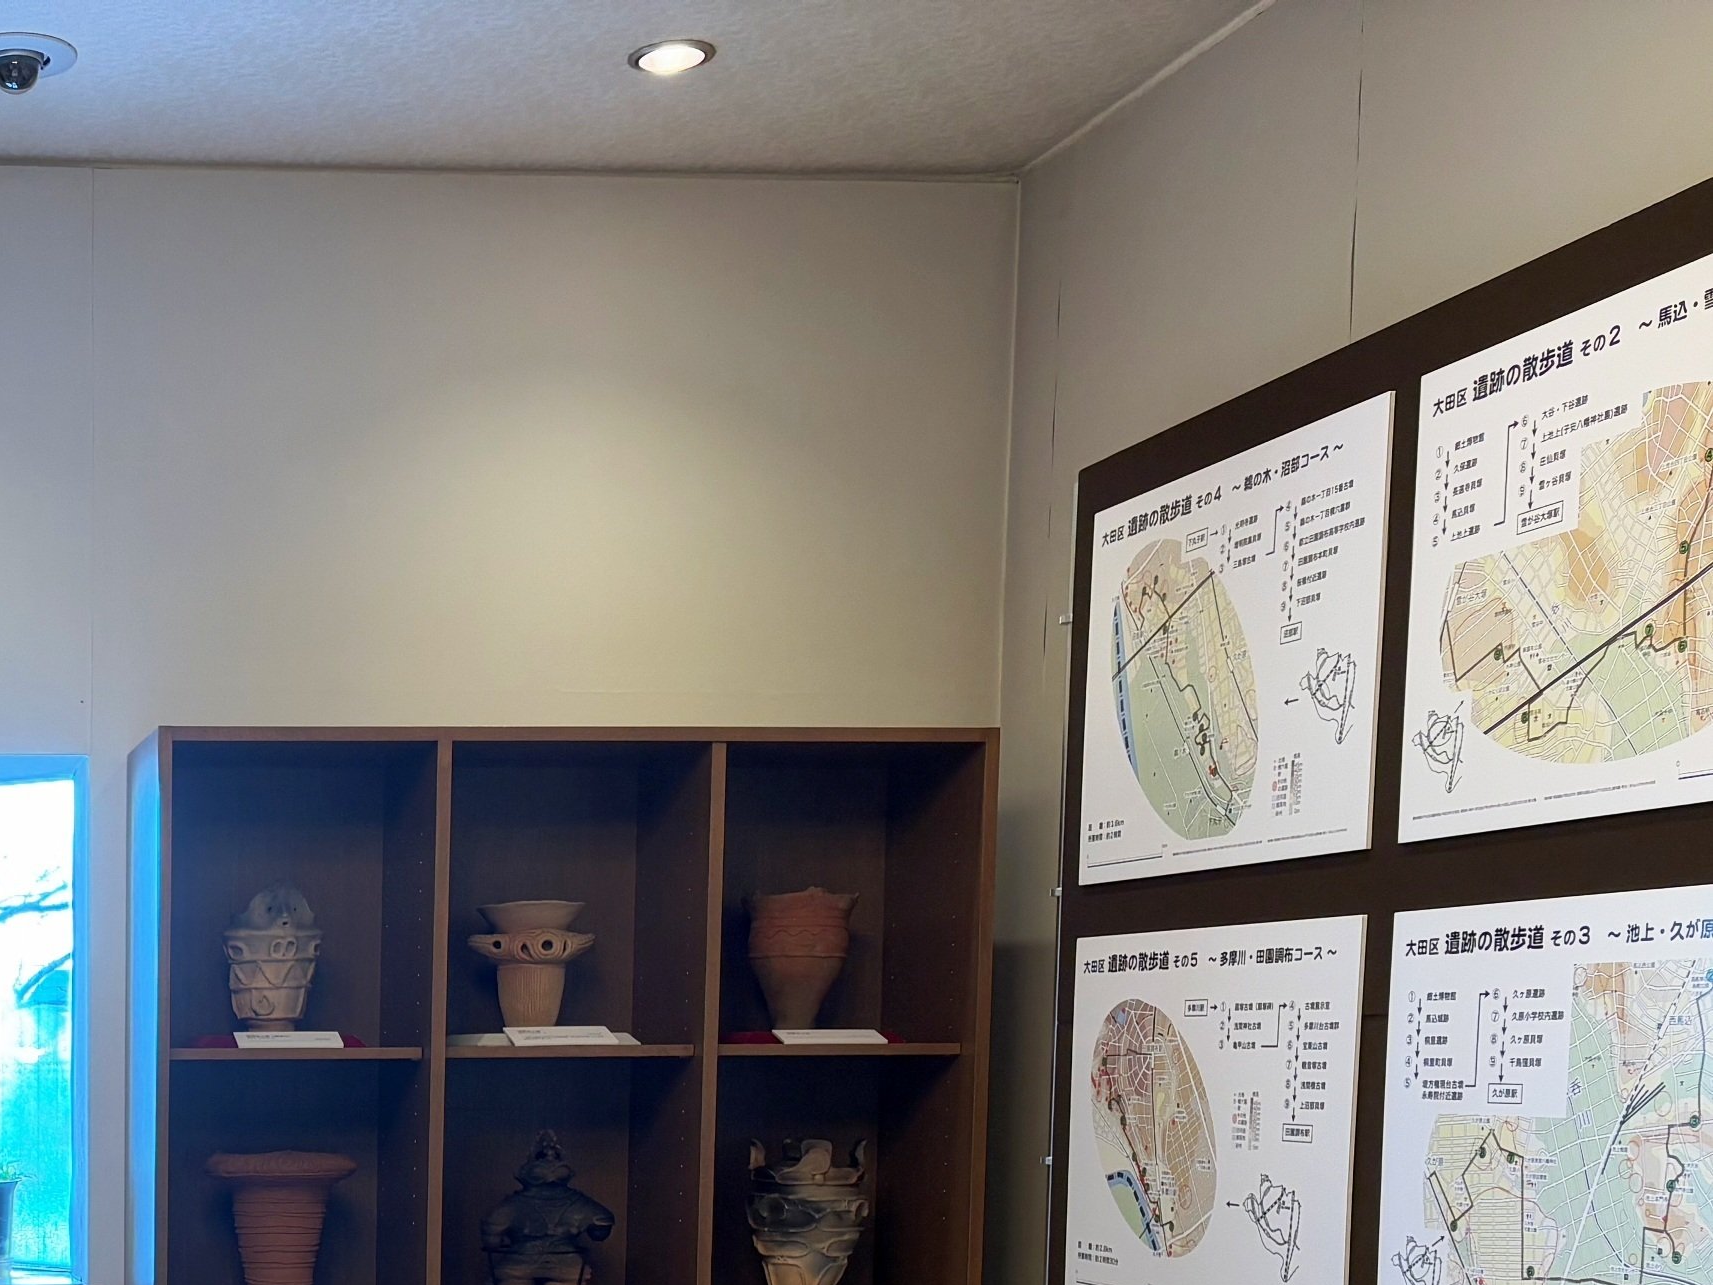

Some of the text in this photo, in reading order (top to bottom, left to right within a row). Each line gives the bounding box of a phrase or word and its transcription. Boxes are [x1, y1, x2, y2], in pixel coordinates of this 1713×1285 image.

[1433, 387, 1468, 417] 大田区
[1473, 339, 1573, 402] 遺跡の散歩道
[1580, 325, 1621, 357] その2
[1102, 525, 1125, 547] 大田区
[1127, 495, 1193, 538] 遺跡の散歩道
[1195, 485, 1222, 510] その4
[1083, 959, 1105, 973] 大田区
[1108, 951, 1169, 973] 遺跡の散歩道
[1173, 952, 1198, 967] その5
[1405, 938, 1440, 957] 大田区
[1445, 925, 1544, 955] 遺跡の散歩道
[1551, 926, 1590, 947] その3
